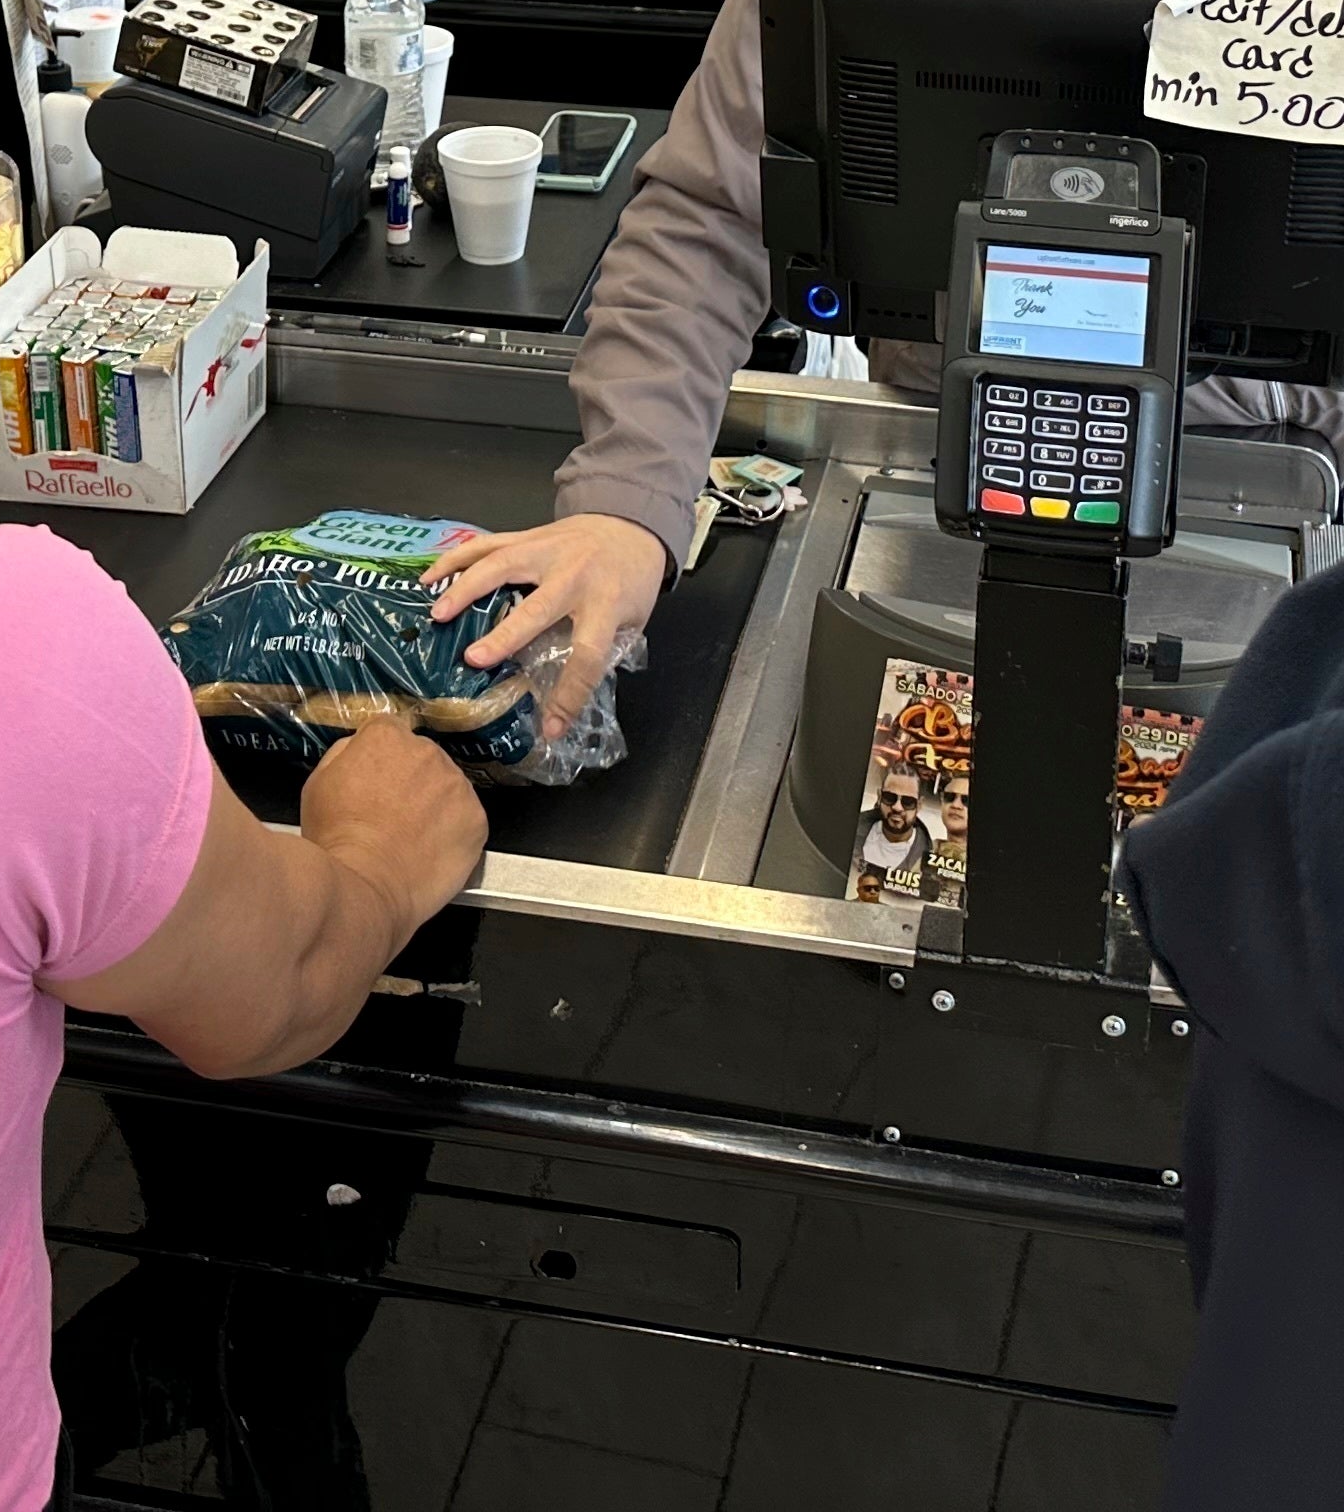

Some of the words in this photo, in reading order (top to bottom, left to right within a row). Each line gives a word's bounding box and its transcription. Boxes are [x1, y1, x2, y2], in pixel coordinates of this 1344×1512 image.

[1150, 72, 1217, 107] min
[1109, 214, 1149, 228] ingenico
[1012, 277, 1054, 297] Thank
[1013, 297, 1047, 319] You
[994, 389, 1001, 400] 1
[1044, 395, 1052, 406] 2
[1095, 399, 1103, 410] 3
[992, 415, 1000, 426] 4
[1042, 421, 1049, 432] 5
[1093, 426, 1100, 437] 6
[990, 442, 998, 453] 7
[1040, 448, 1048, 459] 8
[1090, 453, 1098, 464] 9
[25, 469, 132, 498] Raffaello
[1038, 475, 1047, 486] 0
[317, 515, 432, 539] Green
[309, 525, 413, 553] Giant
[222, 553, 314, 588] IDAHO
[263, 637, 284, 652] NET
[285, 636, 302, 651] WT
[312, 638, 326, 654] LB
[1139, 728, 1162, 741] 29
[1166, 731, 1188, 746] DE
[885, 866, 921, 888] LUIS
